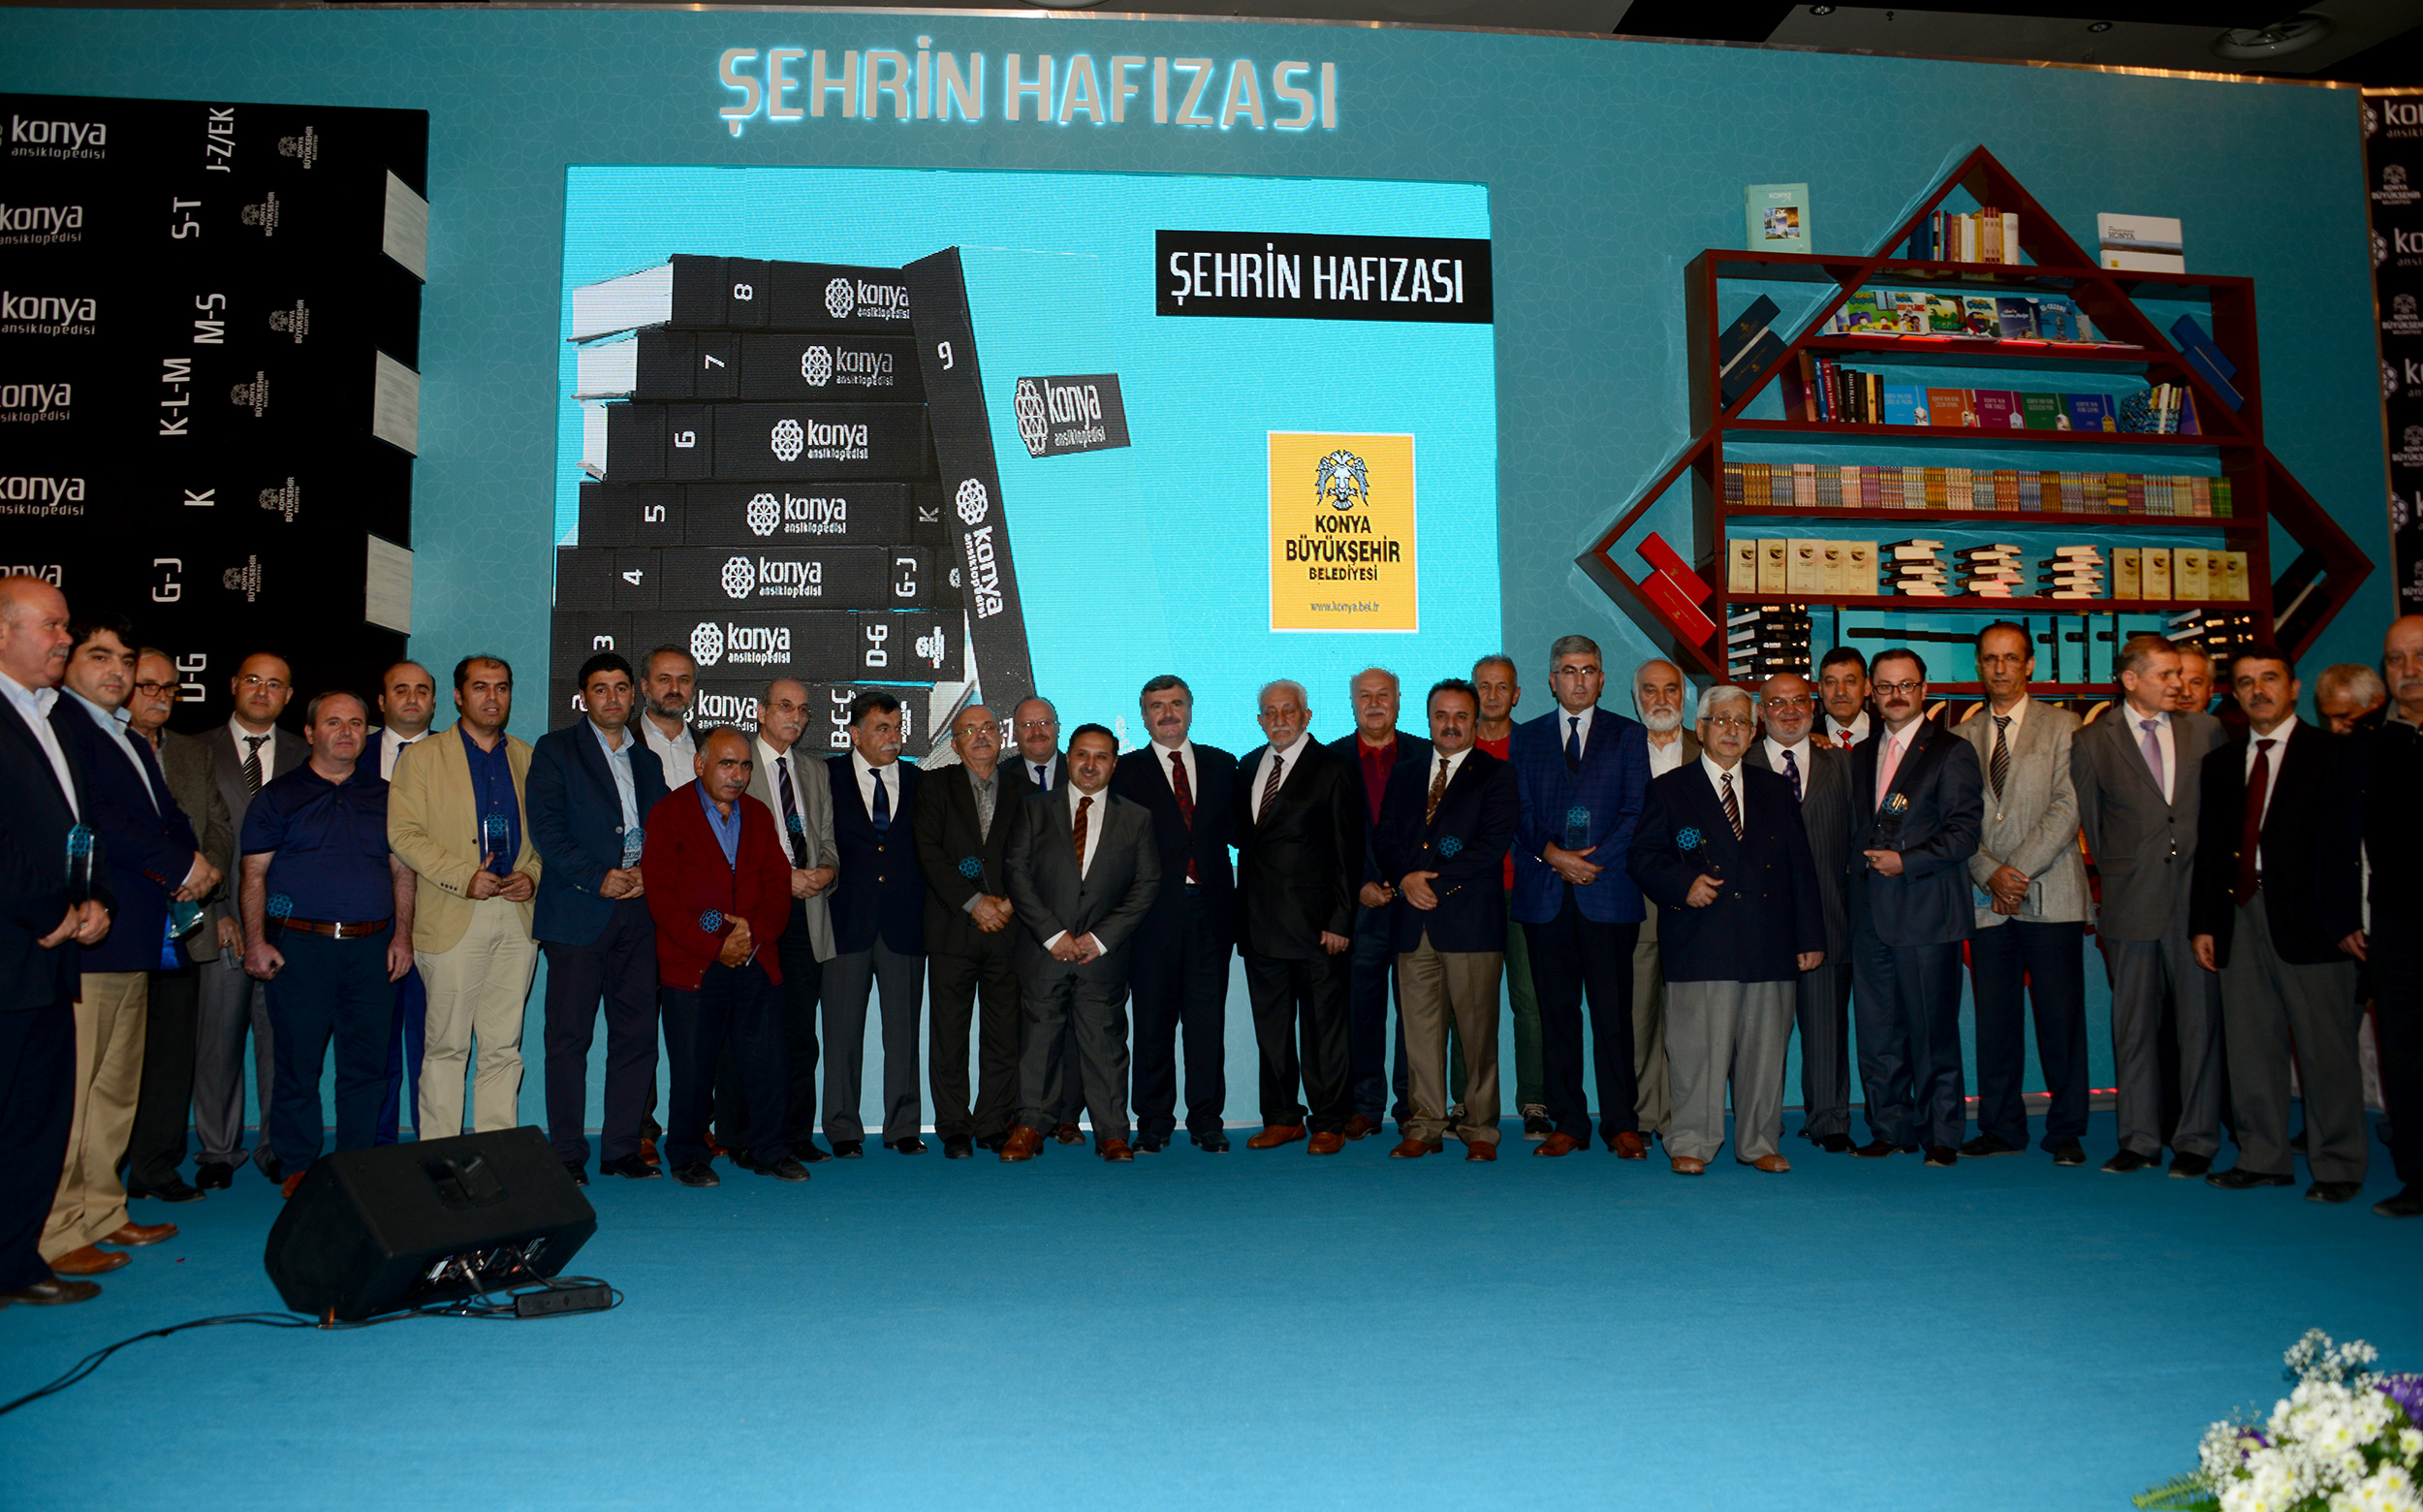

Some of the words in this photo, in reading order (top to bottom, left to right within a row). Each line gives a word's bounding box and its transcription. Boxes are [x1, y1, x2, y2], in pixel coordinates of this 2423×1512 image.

[718, 35, 983, 137] ŞEHRİN
[1006, 53, 1337, 131] HAFIZASI
[12, 114, 107, 150] konya
[205, 107, 236, 173] J-Z/EK
[12, 146, 106, 160] ansiklopedisi
[0, 204, 83, 235] konya
[172, 197, 202, 239] S-T
[1170, 242, 1301, 306] ŞEHRİN
[1313, 255, 1463, 304] HAFIZASI
[734, 283, 753, 300] 8
[857, 279, 910, 313] konya
[2, 291, 97, 327] konya
[194, 293, 227, 344] M-S
[2, 323, 96, 337] ansiklopedisi
[705, 354, 725, 369] 7
[836, 346, 893, 378] konya
[937, 341, 954, 370] 9
[159, 358, 192, 435] K-L-M
[1044, 378, 1102, 430] konya
[807, 419, 868, 451] konya
[184, 488, 215, 506] K
[645, 504, 666, 522] 5
[784, 492, 847, 524] konya
[918, 506, 939, 522] K
[1314, 515, 1372, 534] KONYA
[1285, 535, 1401, 566] BÜYÜKŞEHİR
[152, 557, 182, 603] G-J
[621, 568, 644, 585] 4
[759, 556, 822, 588] konya
[896, 557, 918, 598] G-J
[972, 525, 1004, 616] konya
[1308, 564, 1378, 582] BELEDİYESİ
[1309, 600, 1380, 614] www.konya.bel.tr
[728, 622, 791, 654] konya
[865, 624, 889, 668] D-G
[698, 689, 758, 723] konya
[831, 688, 858, 748] B-C-Ç
